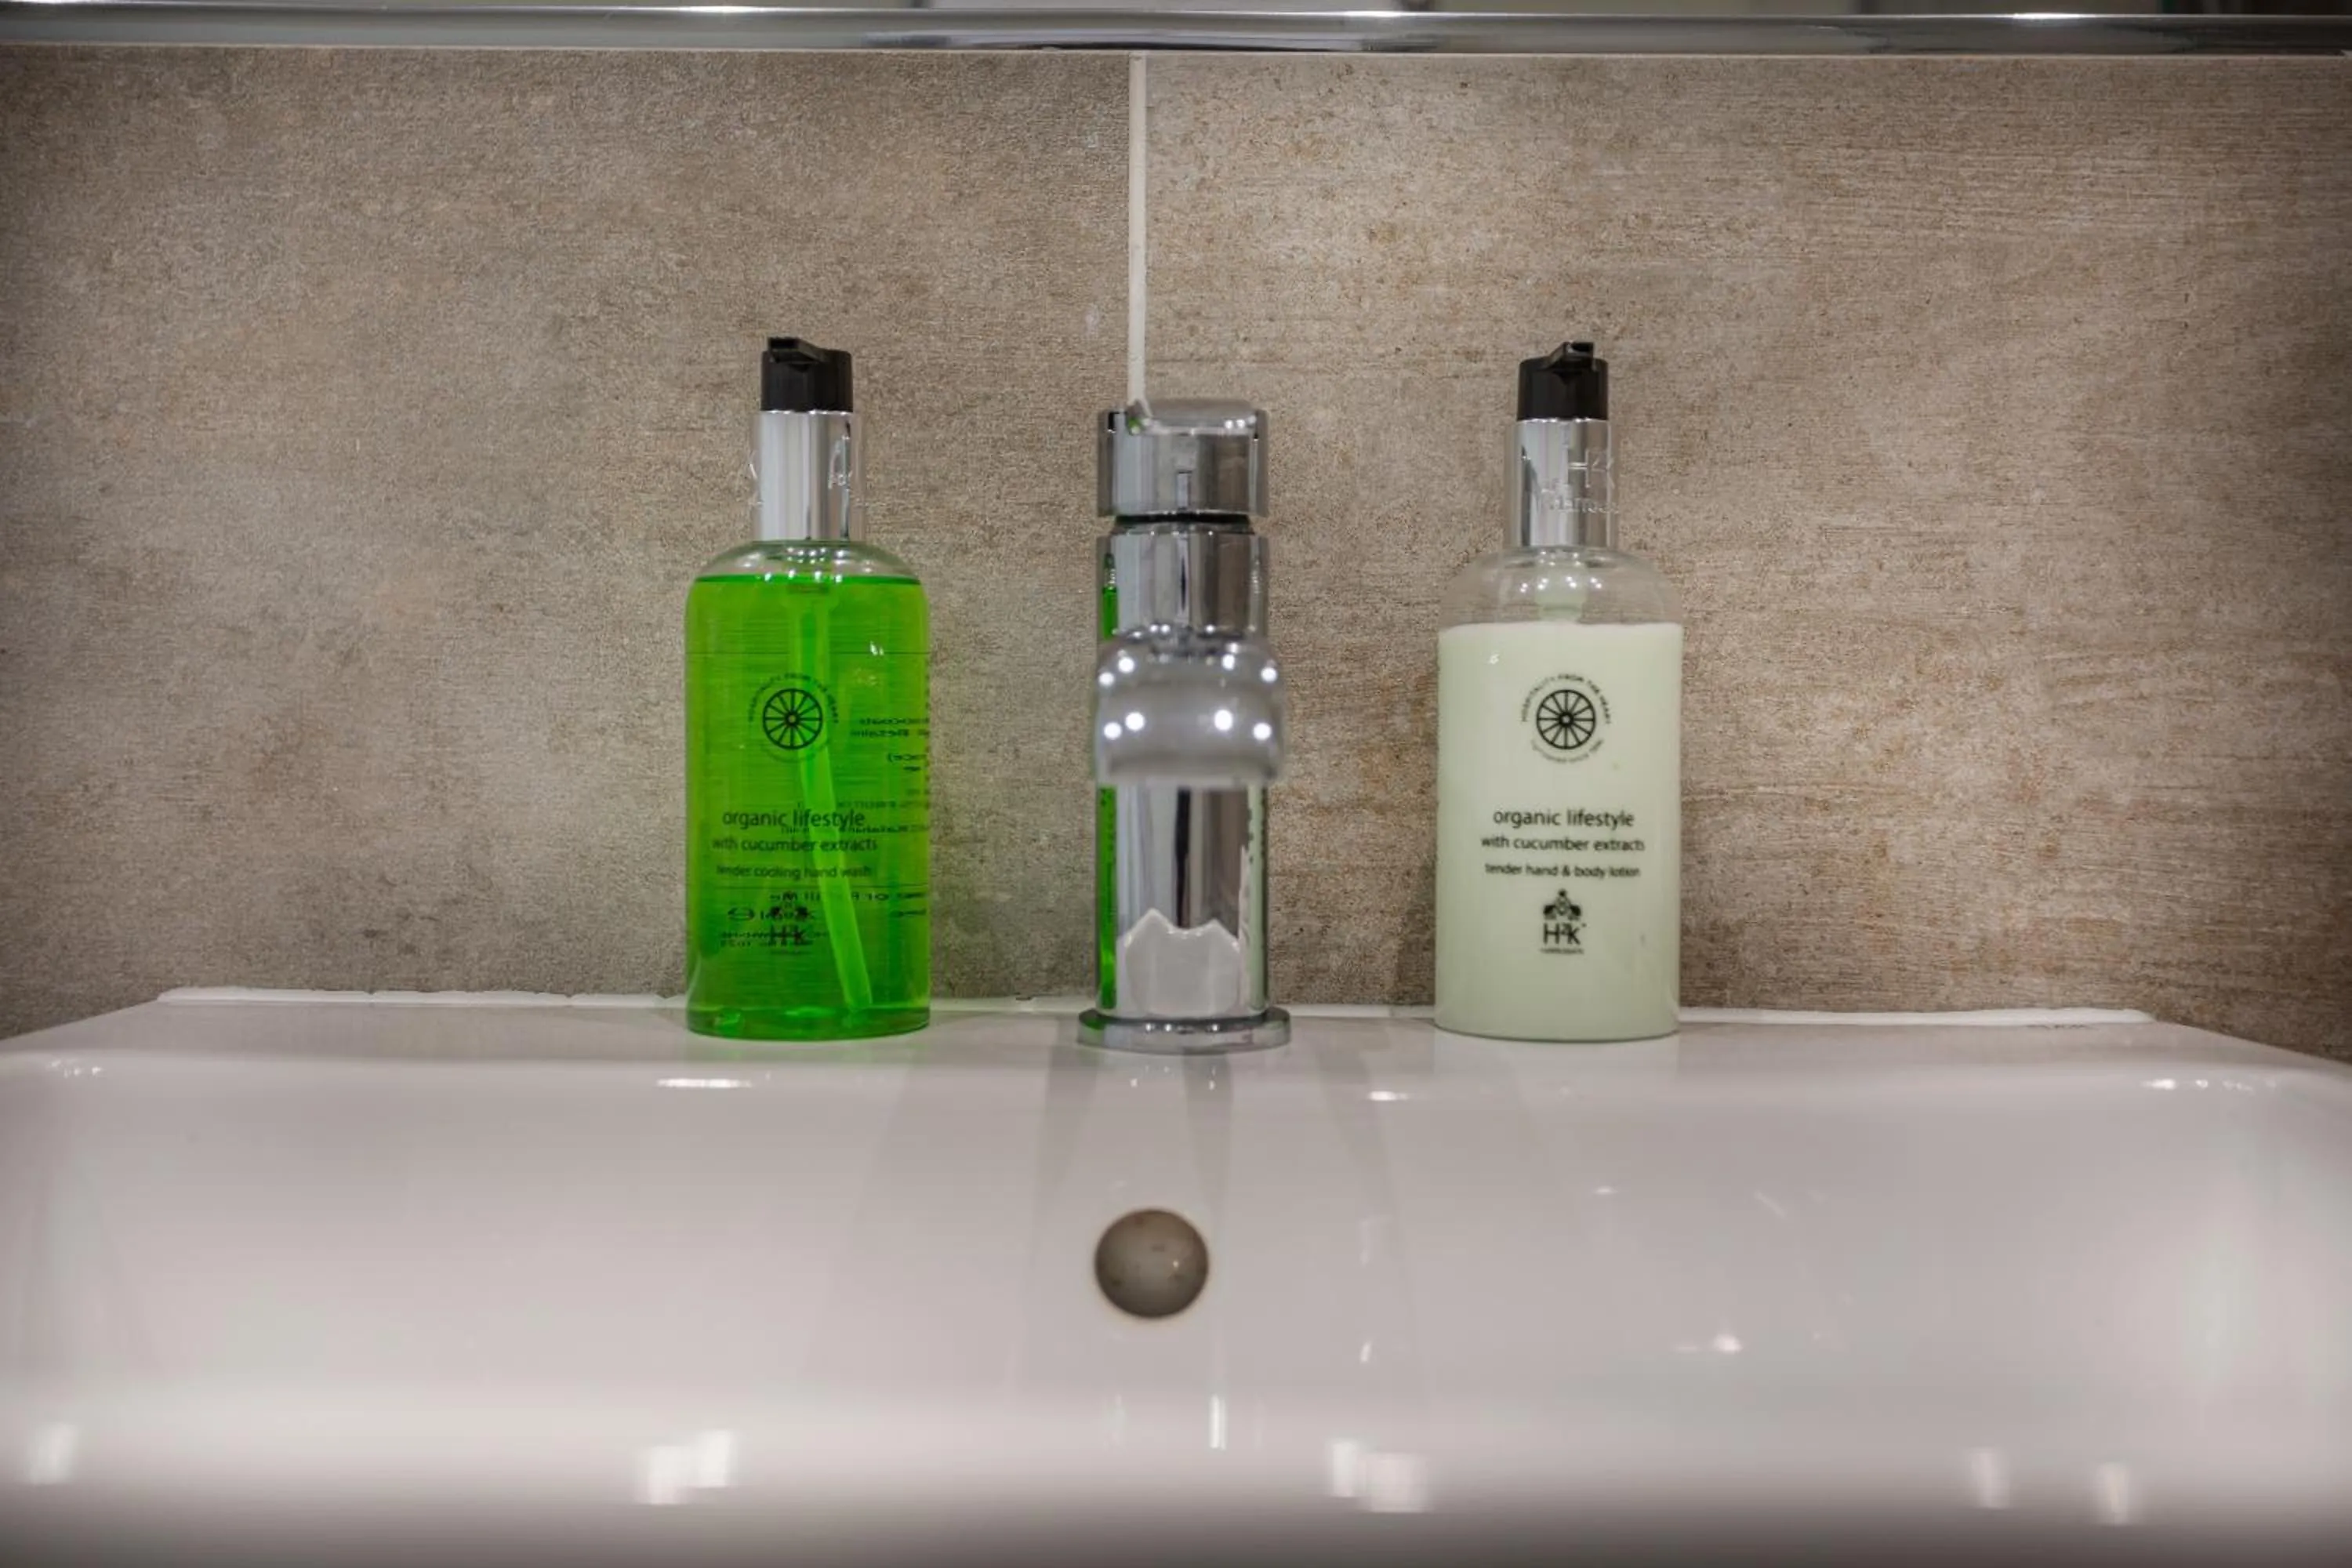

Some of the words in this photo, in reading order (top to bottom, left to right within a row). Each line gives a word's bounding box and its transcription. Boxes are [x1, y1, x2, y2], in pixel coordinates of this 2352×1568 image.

[723, 810, 787, 829] organic
[793, 808, 865, 829] lifestyle
[1494, 811, 1561, 829] organic
[1567, 809, 1635, 829] lifestyle
[713, 838, 738, 850] with
[742, 839, 814, 851] cucumber
[821, 838, 877, 851] extracts
[1481, 836, 1509, 848] with
[1513, 837, 1588, 851] cucumber
[1594, 838, 1645, 851] extracts
[754, 866, 801, 880] cooling
[804, 866, 837, 877] hand
[1485, 863, 1522, 875] tender
[1526, 864, 1558, 877] hand
[1562, 866, 1570, 877] &
[1574, 865, 1606, 880] body
[1609, 866, 1640, 877] lotion
